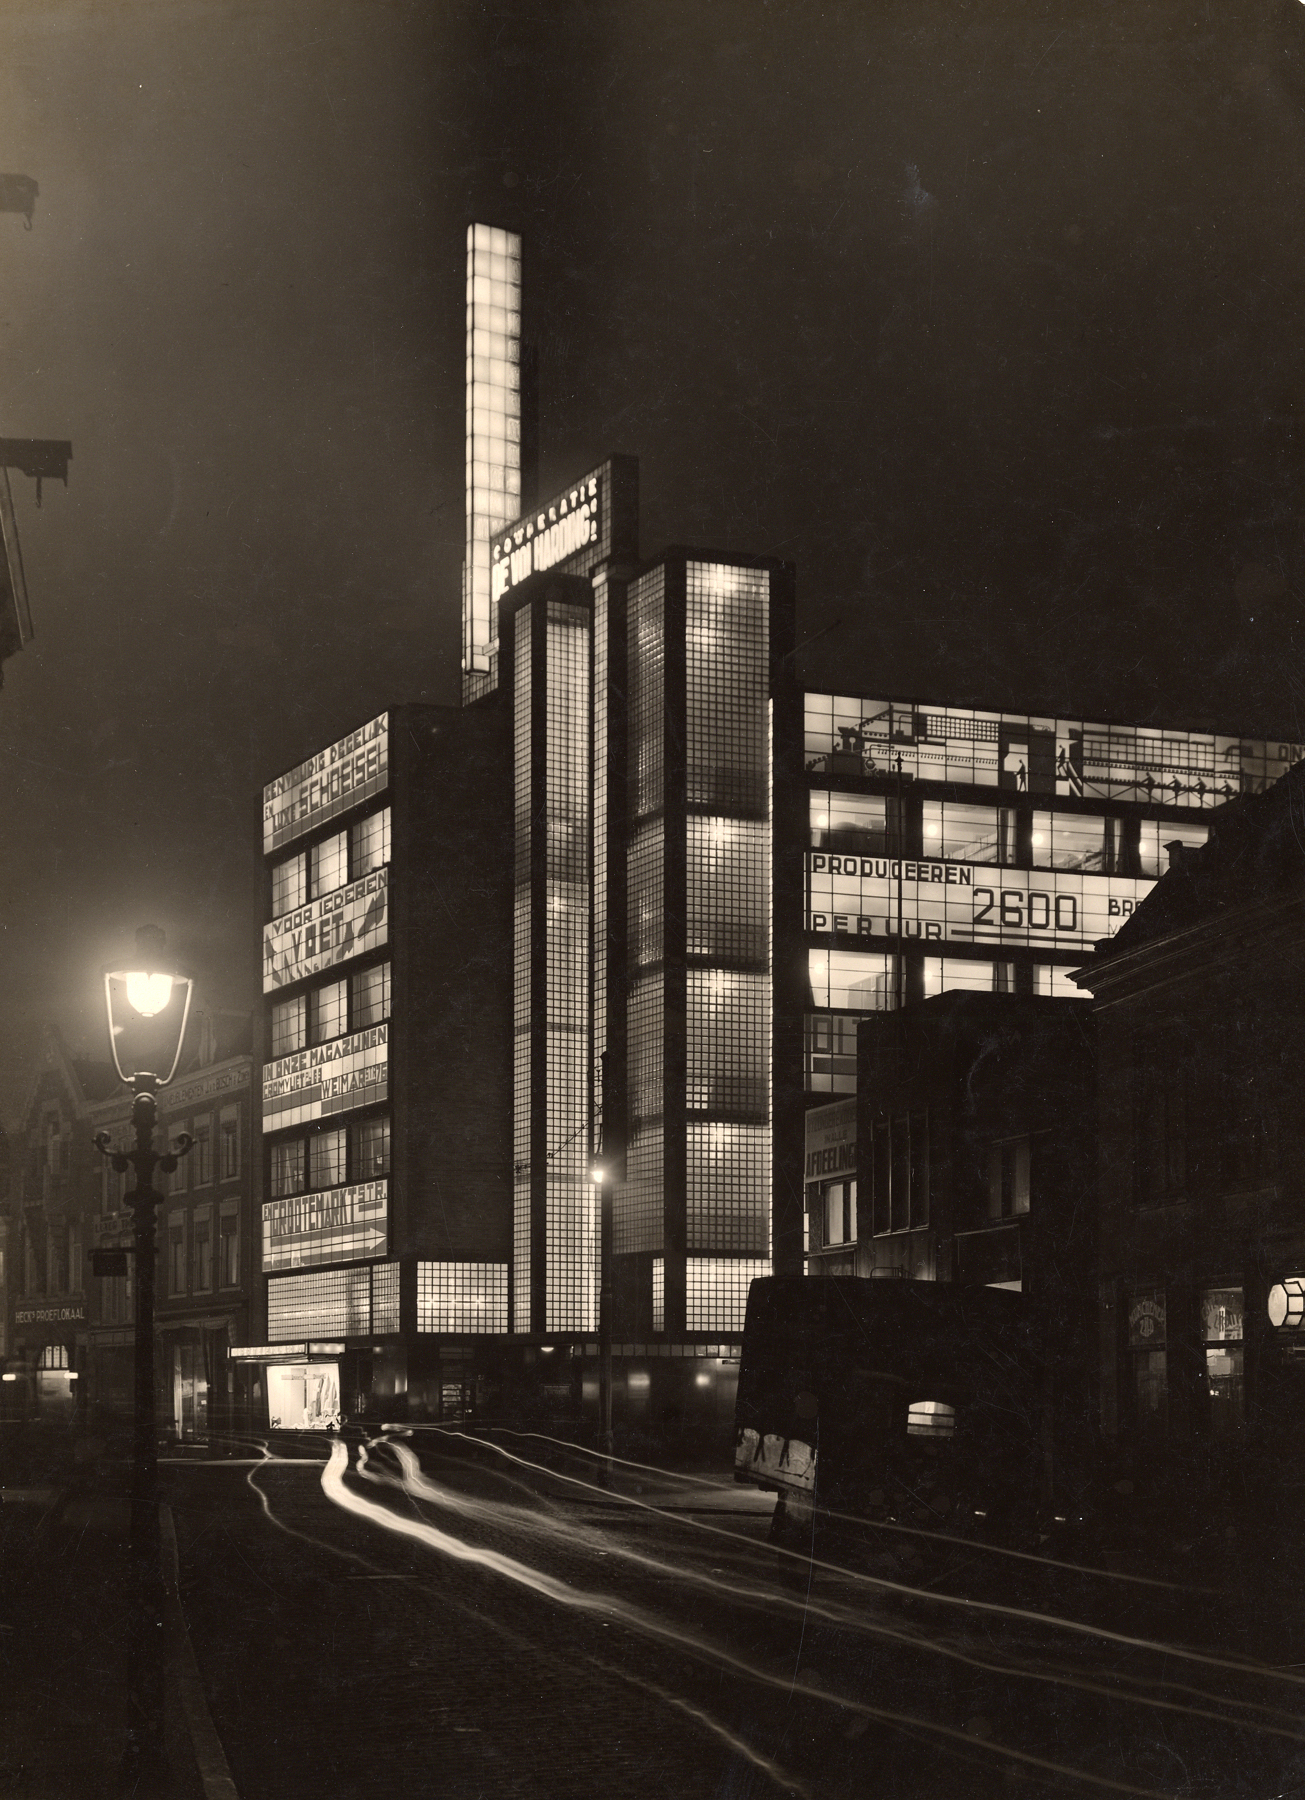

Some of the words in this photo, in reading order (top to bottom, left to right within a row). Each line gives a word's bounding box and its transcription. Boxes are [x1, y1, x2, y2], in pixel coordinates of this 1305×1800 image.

[813, 855, 971, 885] PRODUCEEREN
[273, 906, 312, 935] VOOR
[319, 870, 387, 918] IEDEREN
[973, 888, 1077, 931] 2600
[292, 911, 343, 963] VOET
[813, 914, 872, 935] PER
[885, 918, 942, 940] UUR
[263, 1063, 273, 1083] IN
[275, 1053, 307, 1079] ONZE
[310, 1025, 387, 1067] MAGAZIJNEN
[36, 1307, 84, 1322] PROEFLOKAAL
